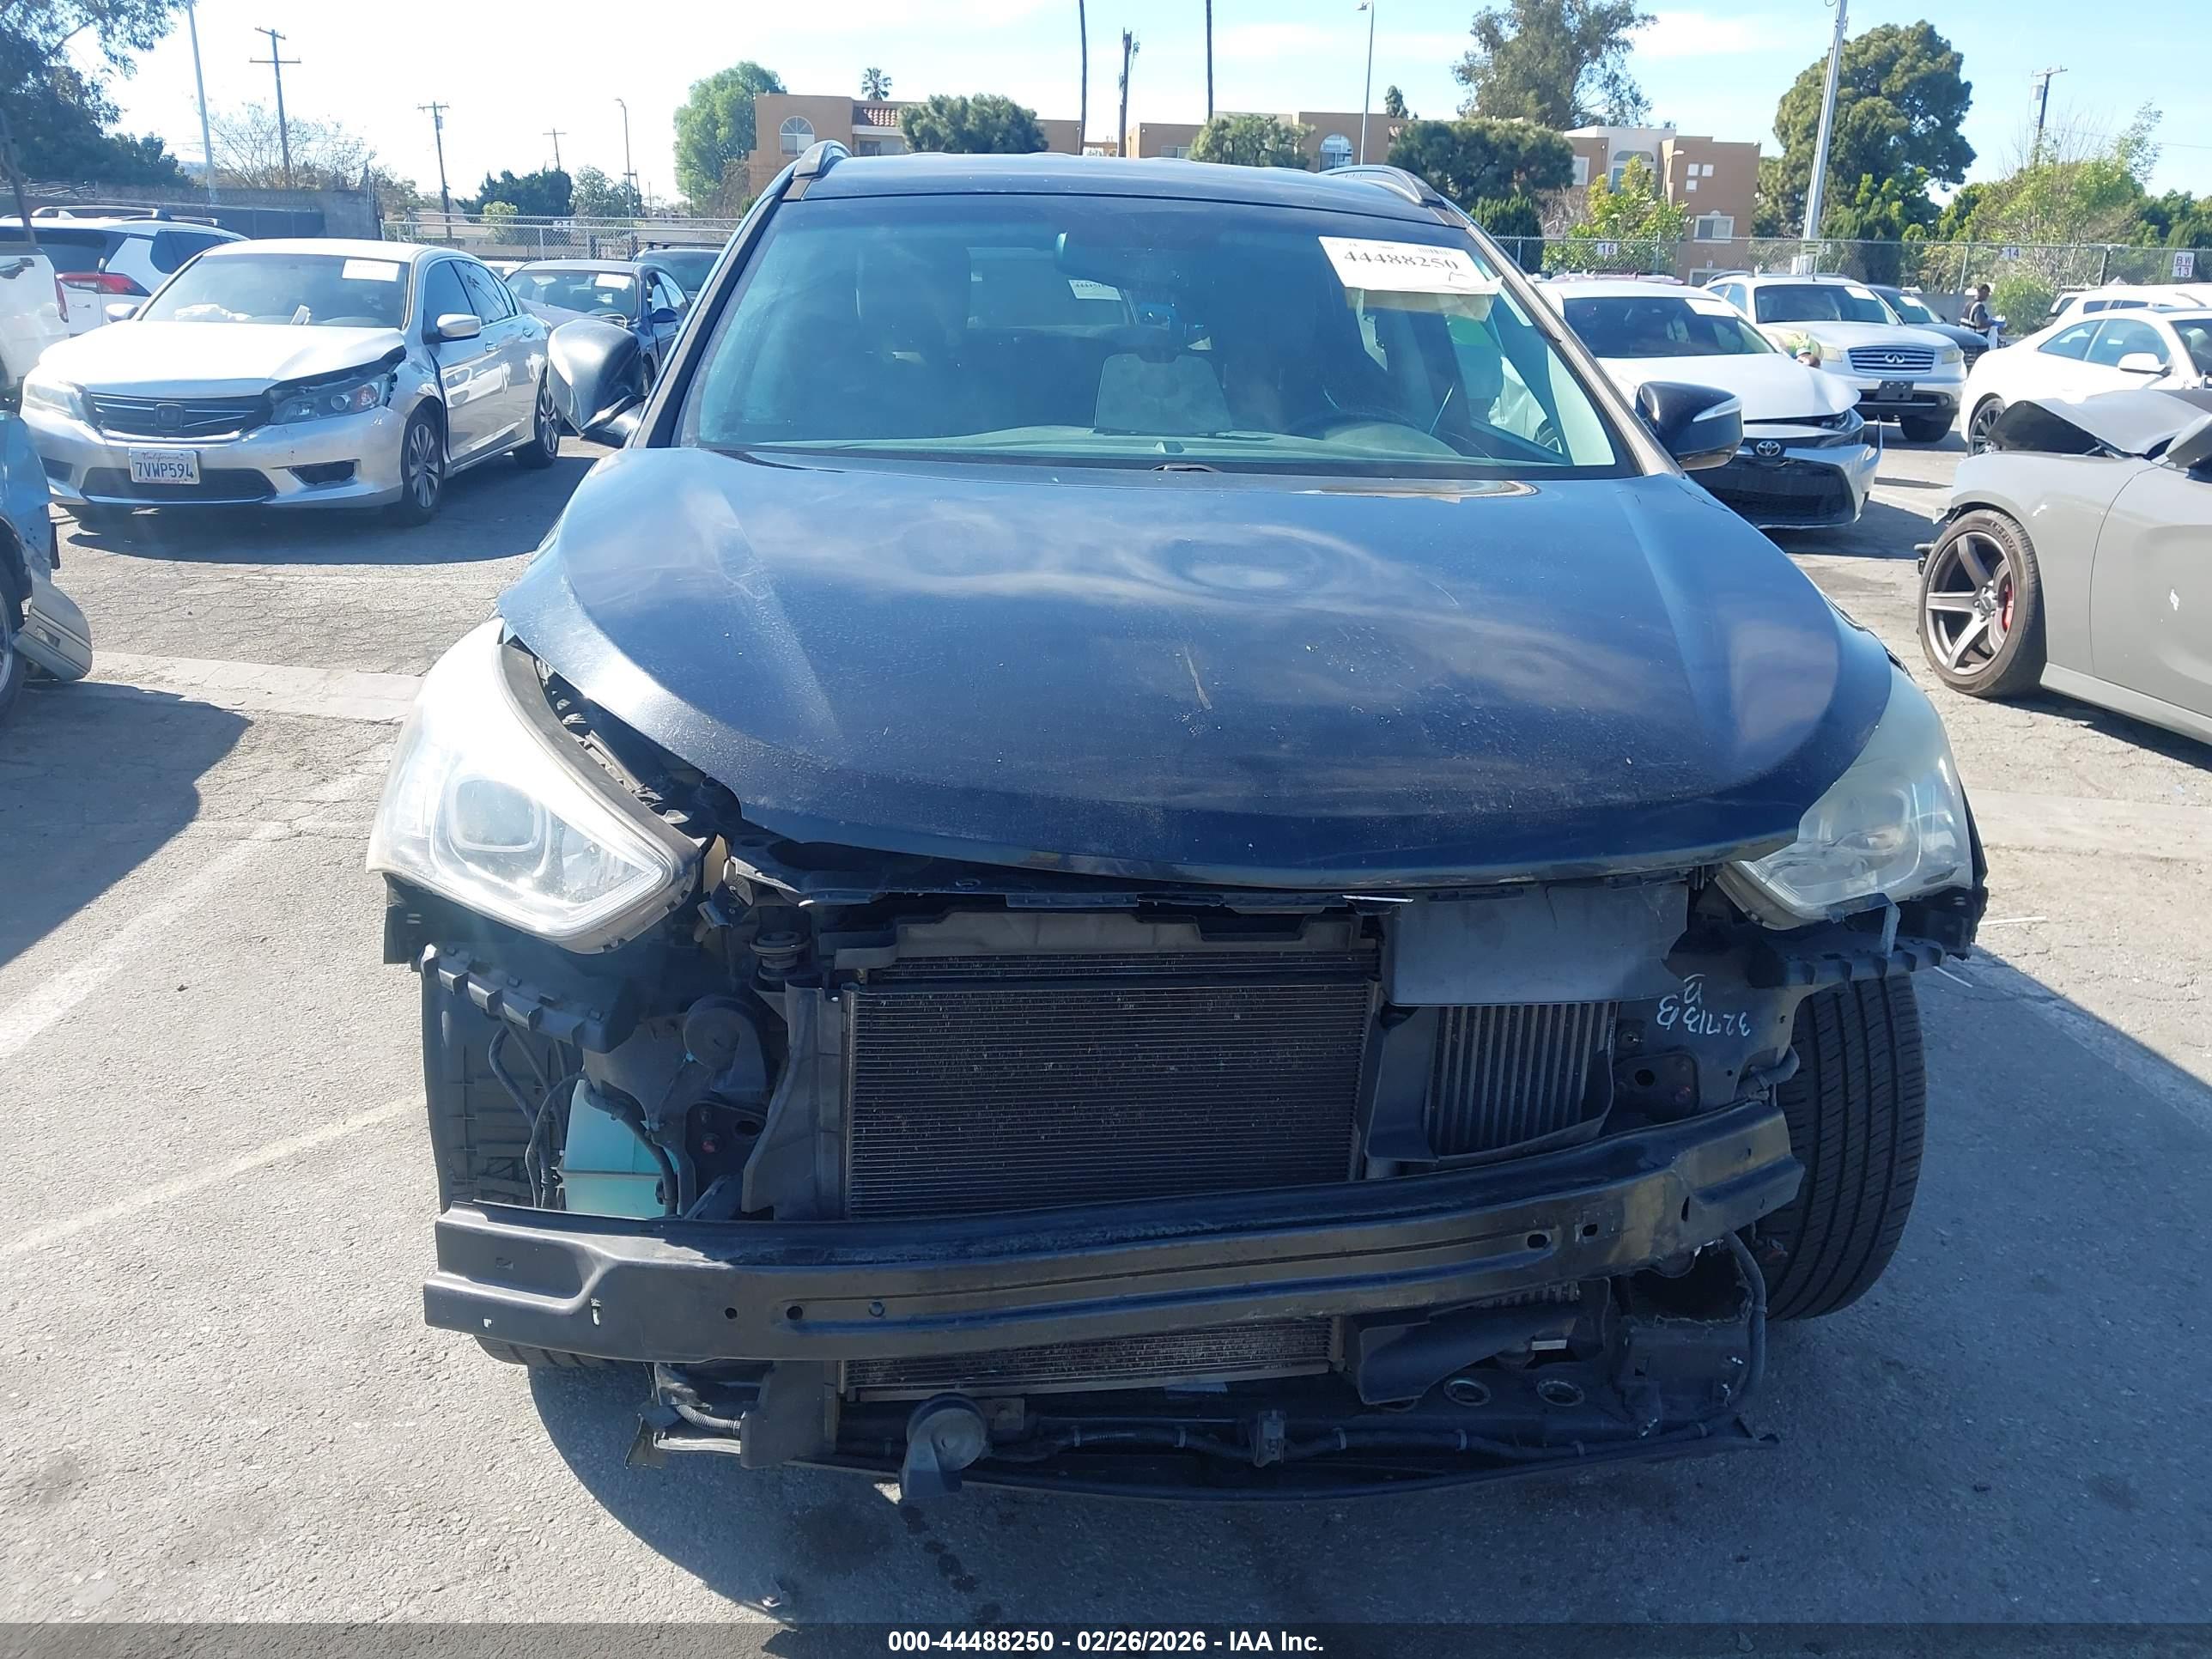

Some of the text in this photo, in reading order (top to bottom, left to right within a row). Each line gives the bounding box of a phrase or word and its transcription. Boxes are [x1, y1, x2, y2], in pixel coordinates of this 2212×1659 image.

[1601, 244, 1614, 254] 16
[1344, 250, 1460, 270] 44488250
[2177, 266, 2190, 276] 13
[135, 462, 194, 478] 7VWP594
